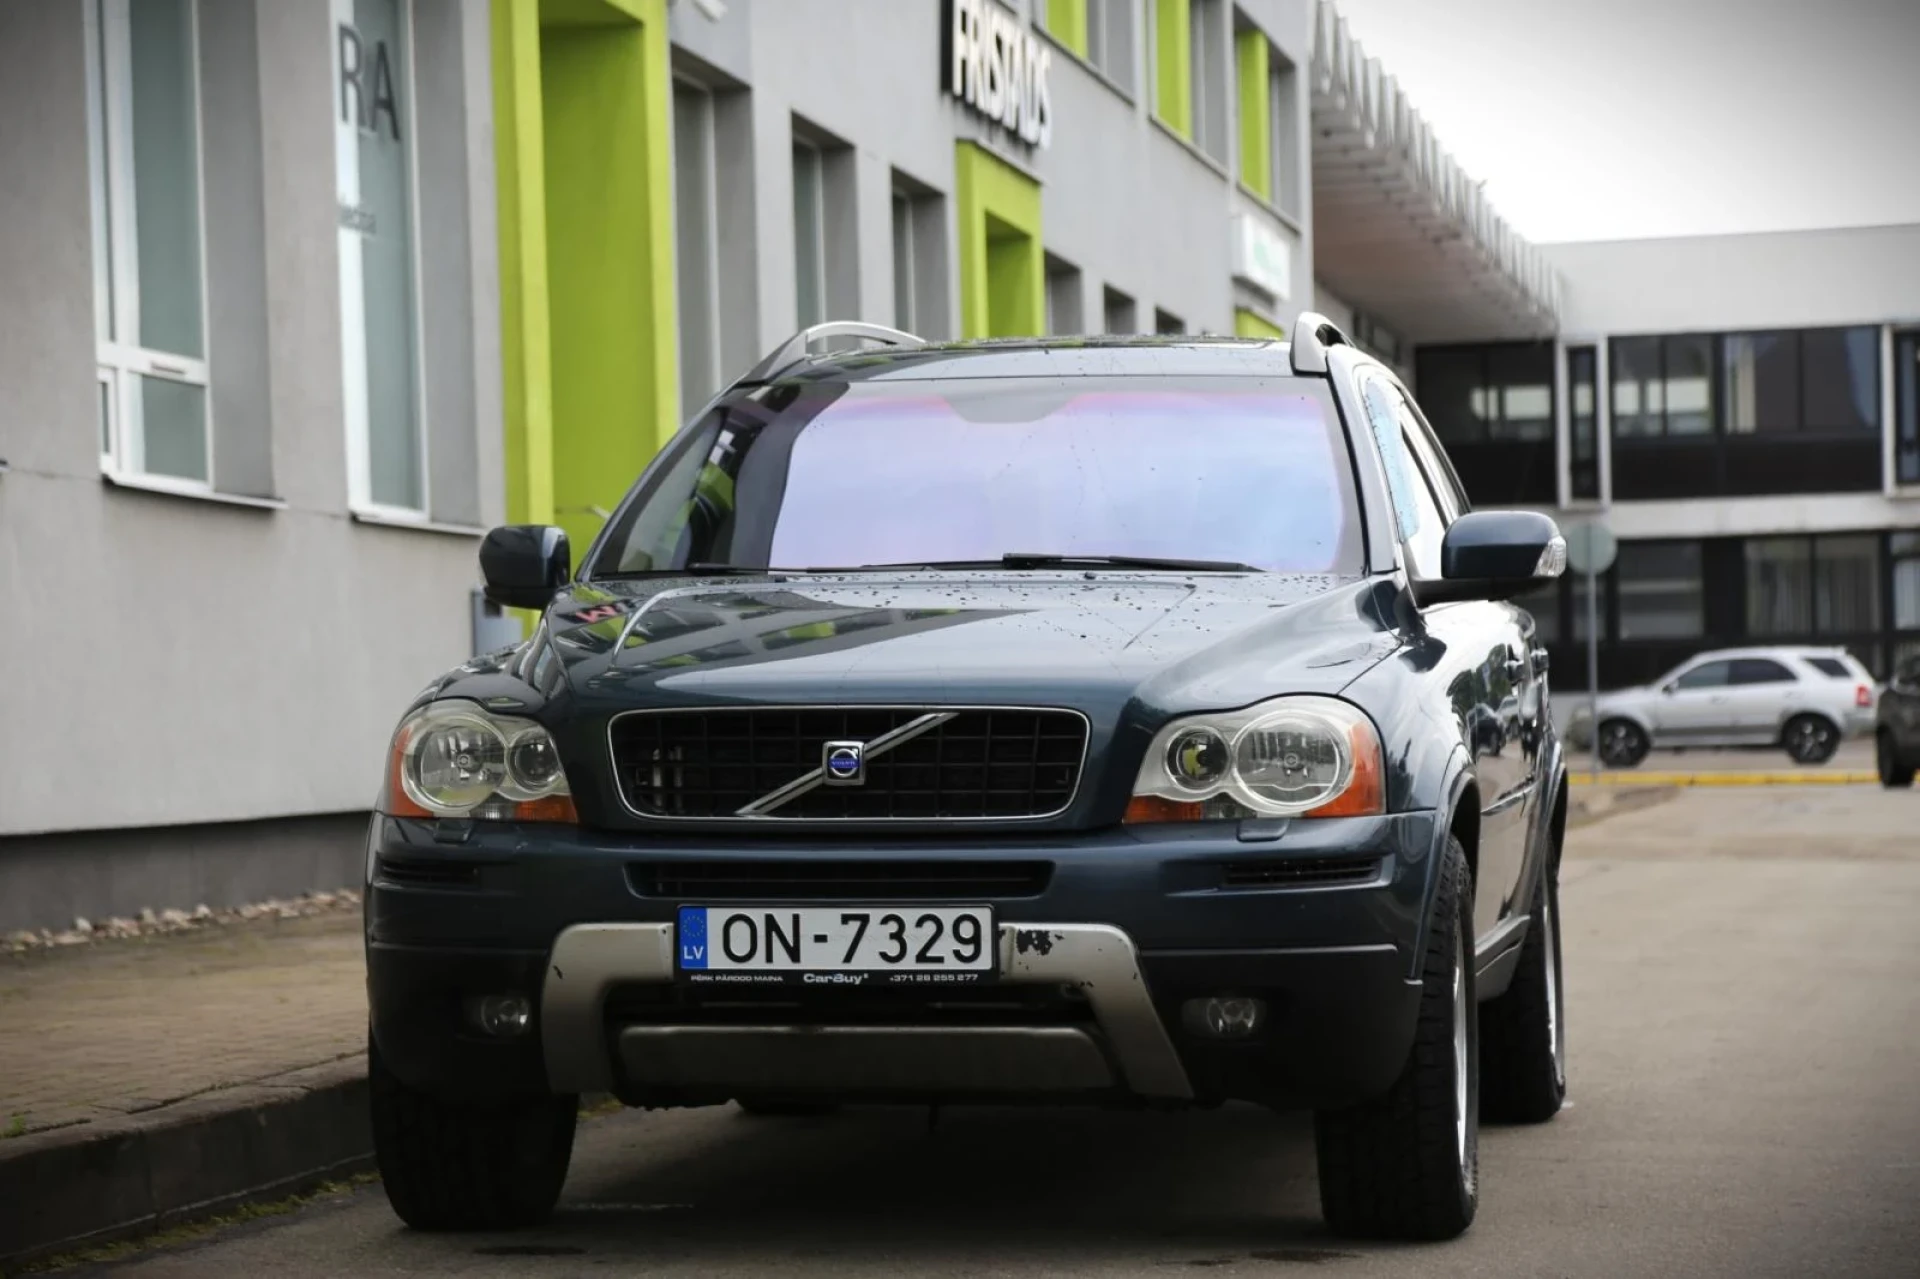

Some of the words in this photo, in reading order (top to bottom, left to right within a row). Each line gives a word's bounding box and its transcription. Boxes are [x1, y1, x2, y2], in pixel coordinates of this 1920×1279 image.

[338, 23, 401, 142] RA
[683, 945, 704, 960] LV
[722, 912, 982, 965] ON-7329
[754, 974, 783, 982] MAINA
